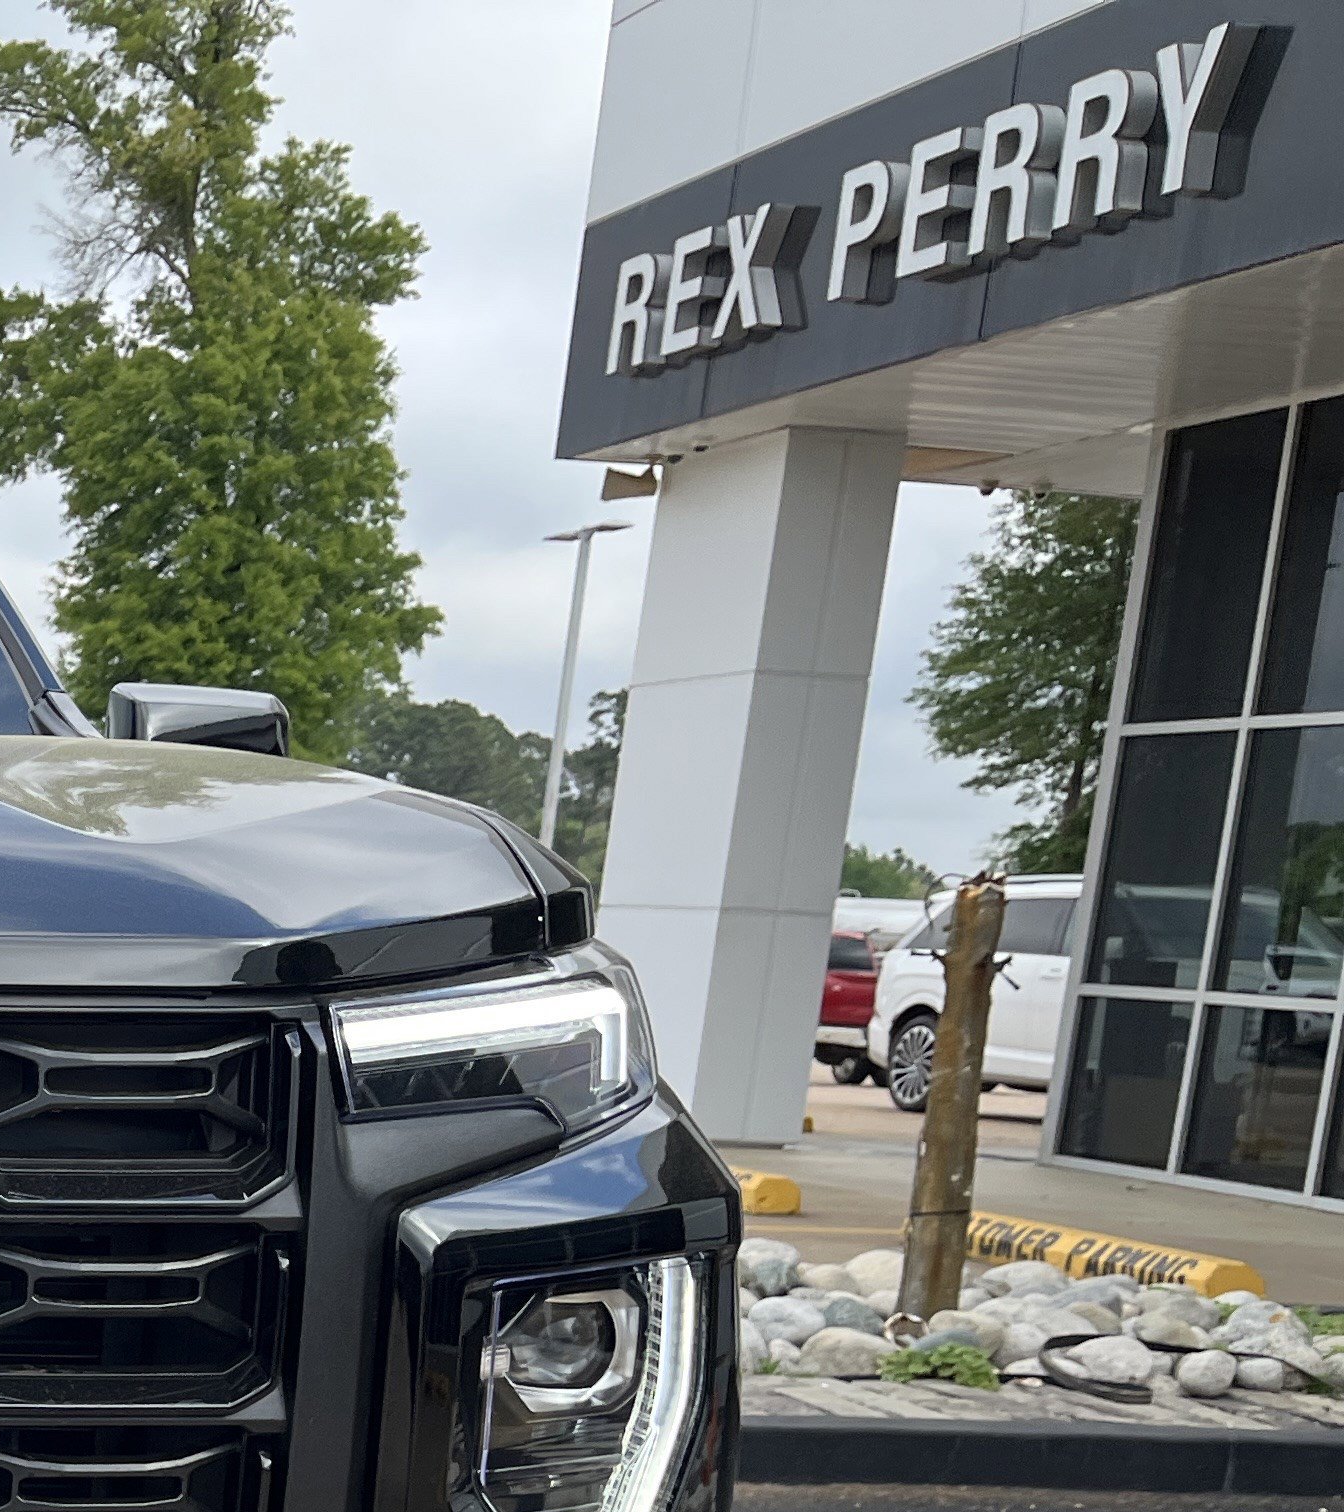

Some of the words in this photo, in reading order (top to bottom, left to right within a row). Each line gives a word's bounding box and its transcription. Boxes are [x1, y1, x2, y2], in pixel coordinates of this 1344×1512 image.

[605, 202, 772, 376] REX
[827, 21, 1231, 302] PERRY
[967, 1217, 1062, 1262] TOMER
[1065, 1238, 1199, 1286] PARKING
